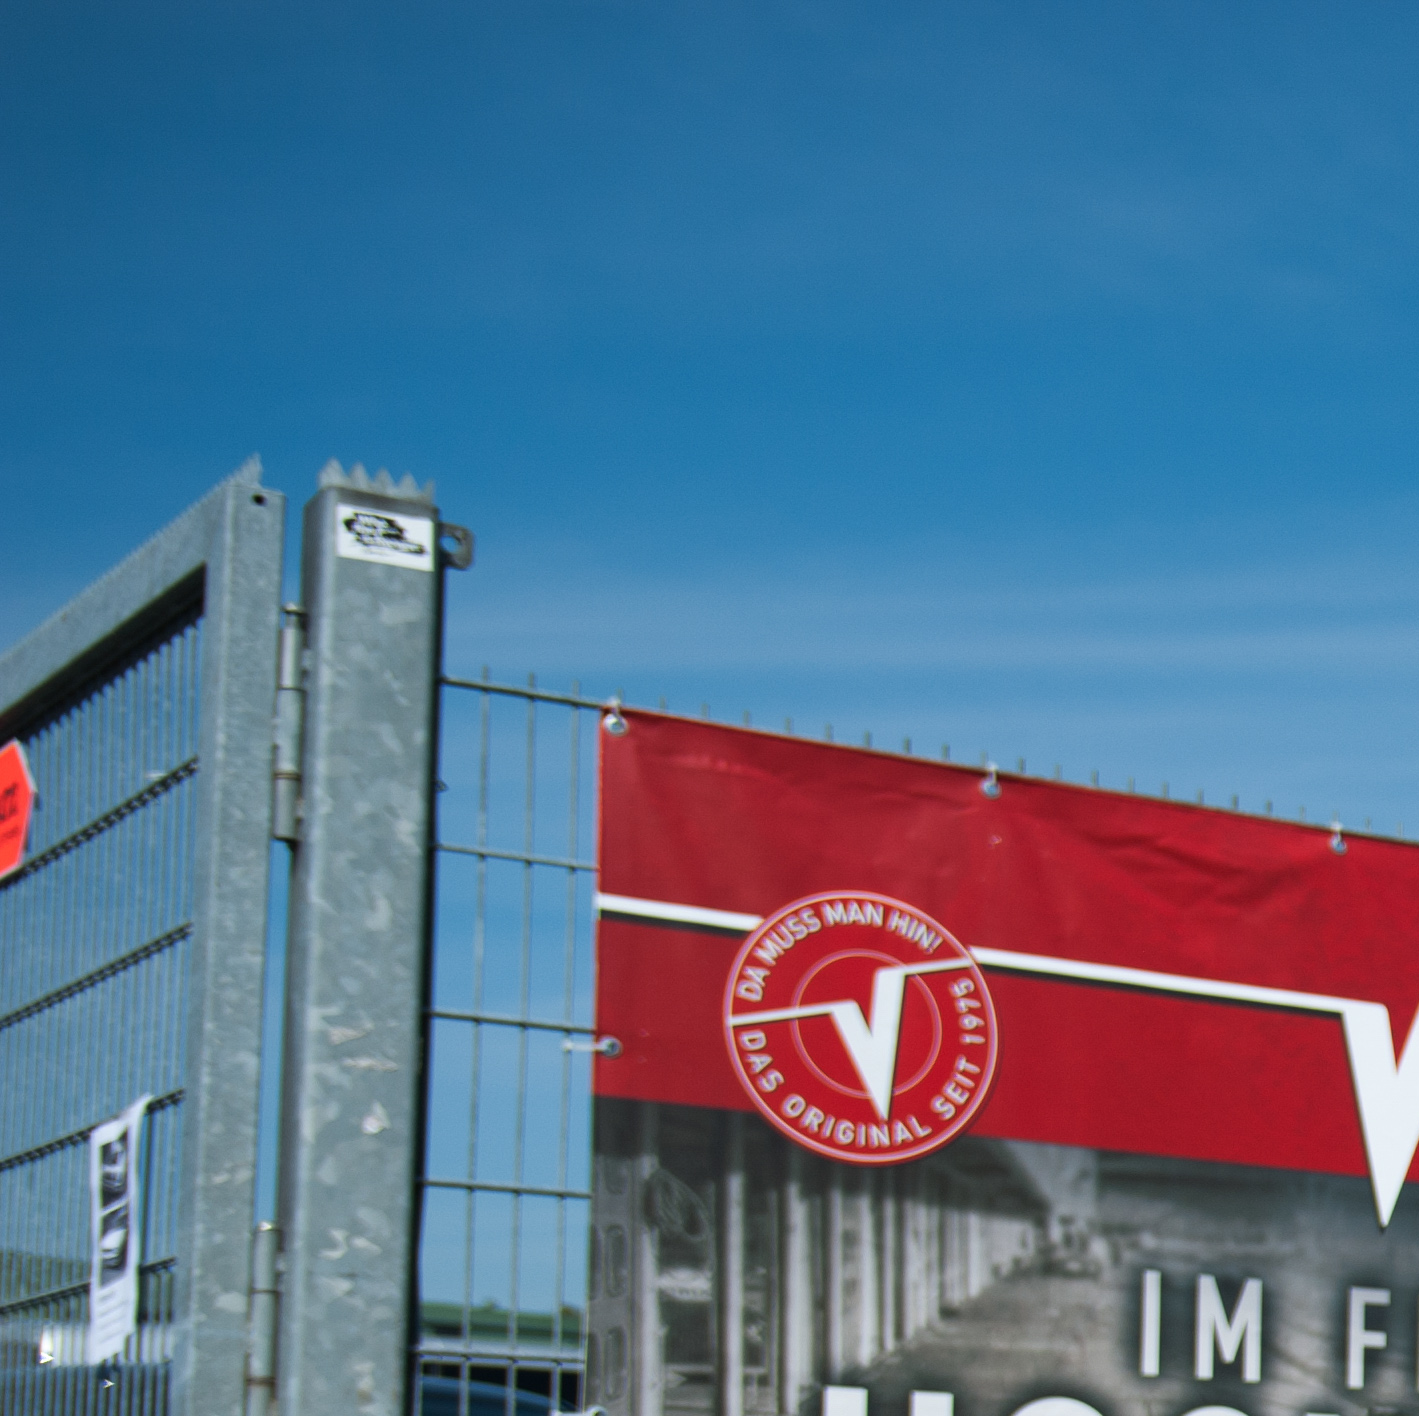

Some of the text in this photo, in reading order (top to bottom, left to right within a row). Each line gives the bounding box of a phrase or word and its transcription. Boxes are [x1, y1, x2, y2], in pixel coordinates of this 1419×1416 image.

[736, 901, 943, 1003] DA MUSS MAN HIN!
[738, 975, 987, 1149] DAS ORIGINAL SEIT 1975
[1138, 1268, 1264, 1384] IM
